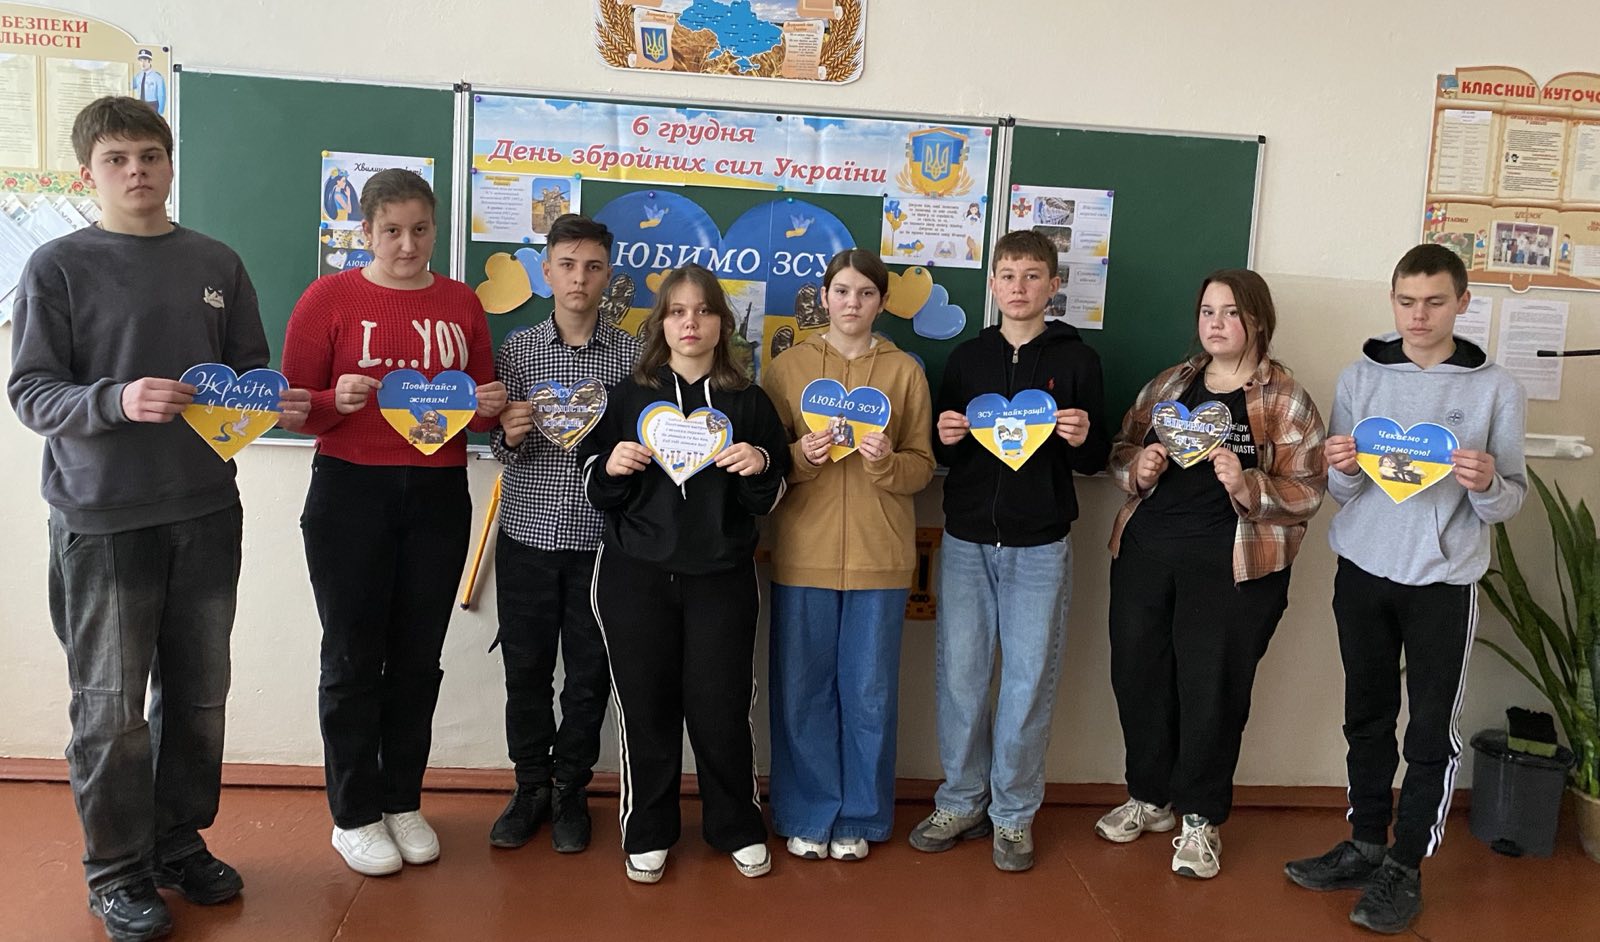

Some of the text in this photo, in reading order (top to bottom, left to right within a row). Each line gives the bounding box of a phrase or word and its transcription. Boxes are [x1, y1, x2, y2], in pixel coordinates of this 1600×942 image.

[2, 15, 89, 34] БЕЗПЕКИ
[0, 32, 81, 49] ЛЬНОСТІ
[1462, 81, 1536, 98] КЛАСНИЙ
[632, 115, 756, 145] 6 грудня
[487, 139, 887, 185] День збройних сил України
[402, 382, 457, 392] Повертайся
[409, 396, 449, 404] живим!
[809, 394, 885, 415] ЛЮБЛЮ ЗСУ!
[977, 410, 993, 418] ЗСУ
[1003, 407, 1046, 417] найкращі!
[1378, 430, 1420, 442] Чекаємо
[1232, 445, 1255, 454] WASTE
[1373, 444, 1431, 457] перемогою!
